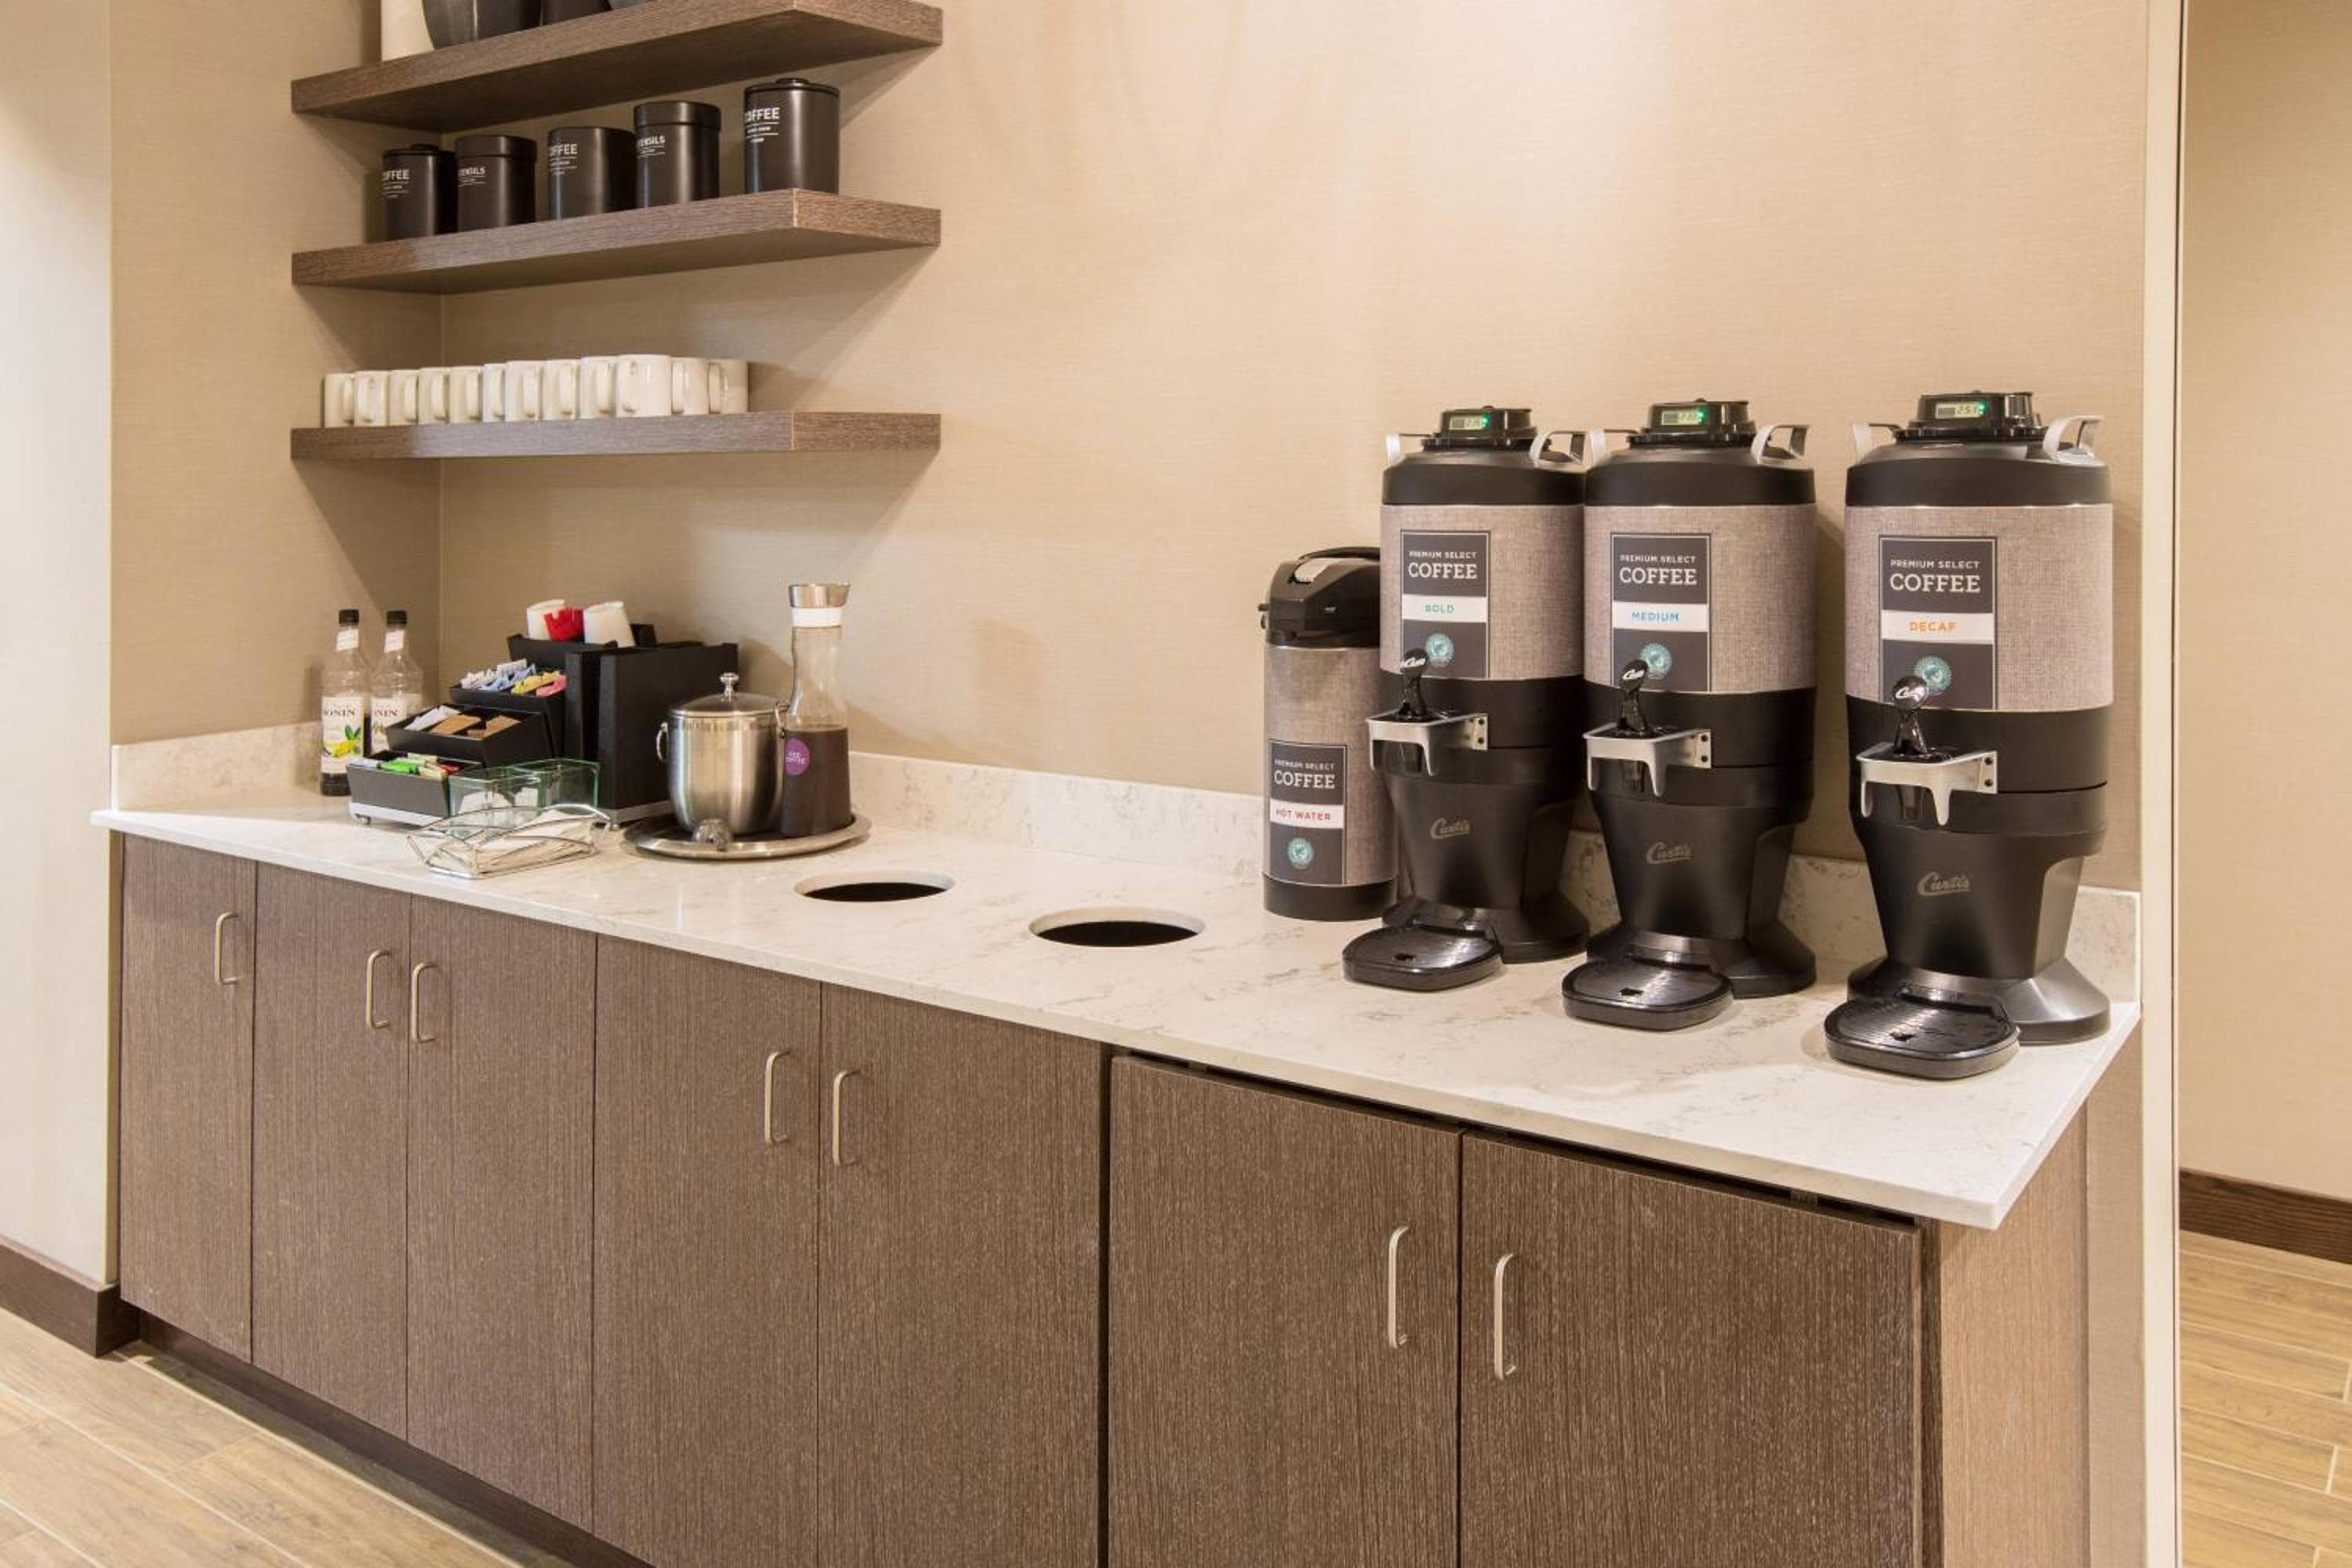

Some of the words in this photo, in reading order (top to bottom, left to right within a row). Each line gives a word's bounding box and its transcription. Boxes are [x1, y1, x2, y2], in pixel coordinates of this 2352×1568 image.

[745, 107, 780, 123] OFFEE
[1444, 551, 1478, 560] SELECT
[1620, 554, 1658, 564] PREMIUM
[1660, 555, 1697, 564] SELECT
[1889, 559, 1935, 570] PREMIUM
[1937, 560, 1980, 570] SELECT
[1407, 562, 1478, 580] COFFEE
[1619, 567, 1697, 586] COFFEE
[1889, 573, 1981, 593] COFFEE
[1425, 604, 1455, 614] BOLD
[1631, 611, 1680, 622] MEDIUM
[1908, 621, 1958, 632] DECAF
[1305, 762, 1335, 771] SELECT
[1273, 769, 1335, 789] COFFEE
[1276, 808, 1294, 818] HOT
[1295, 811, 1331, 822] WATER
